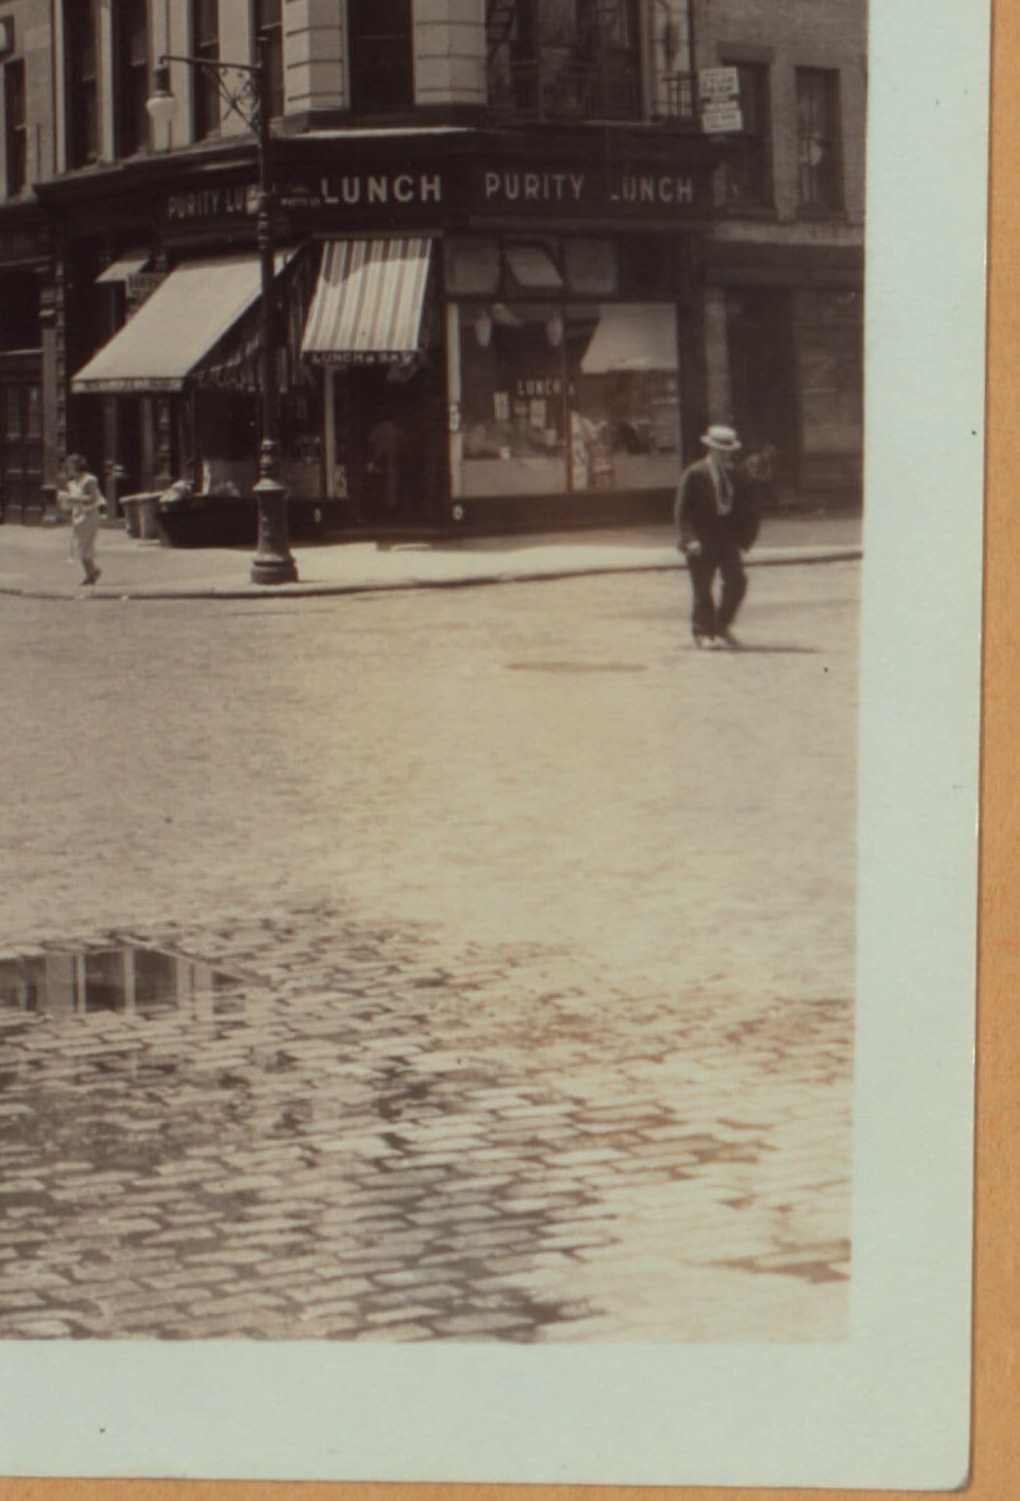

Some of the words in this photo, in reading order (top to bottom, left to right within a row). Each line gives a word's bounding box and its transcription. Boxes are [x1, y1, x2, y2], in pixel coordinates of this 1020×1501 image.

[321, 174, 442, 204] LUNCH
[484, 171, 584, 201] PURITY
[167, 192, 220, 219] PURITY
[311, 352, 364, 365] LUNCH
[516, 379, 562, 396] LUNCH
